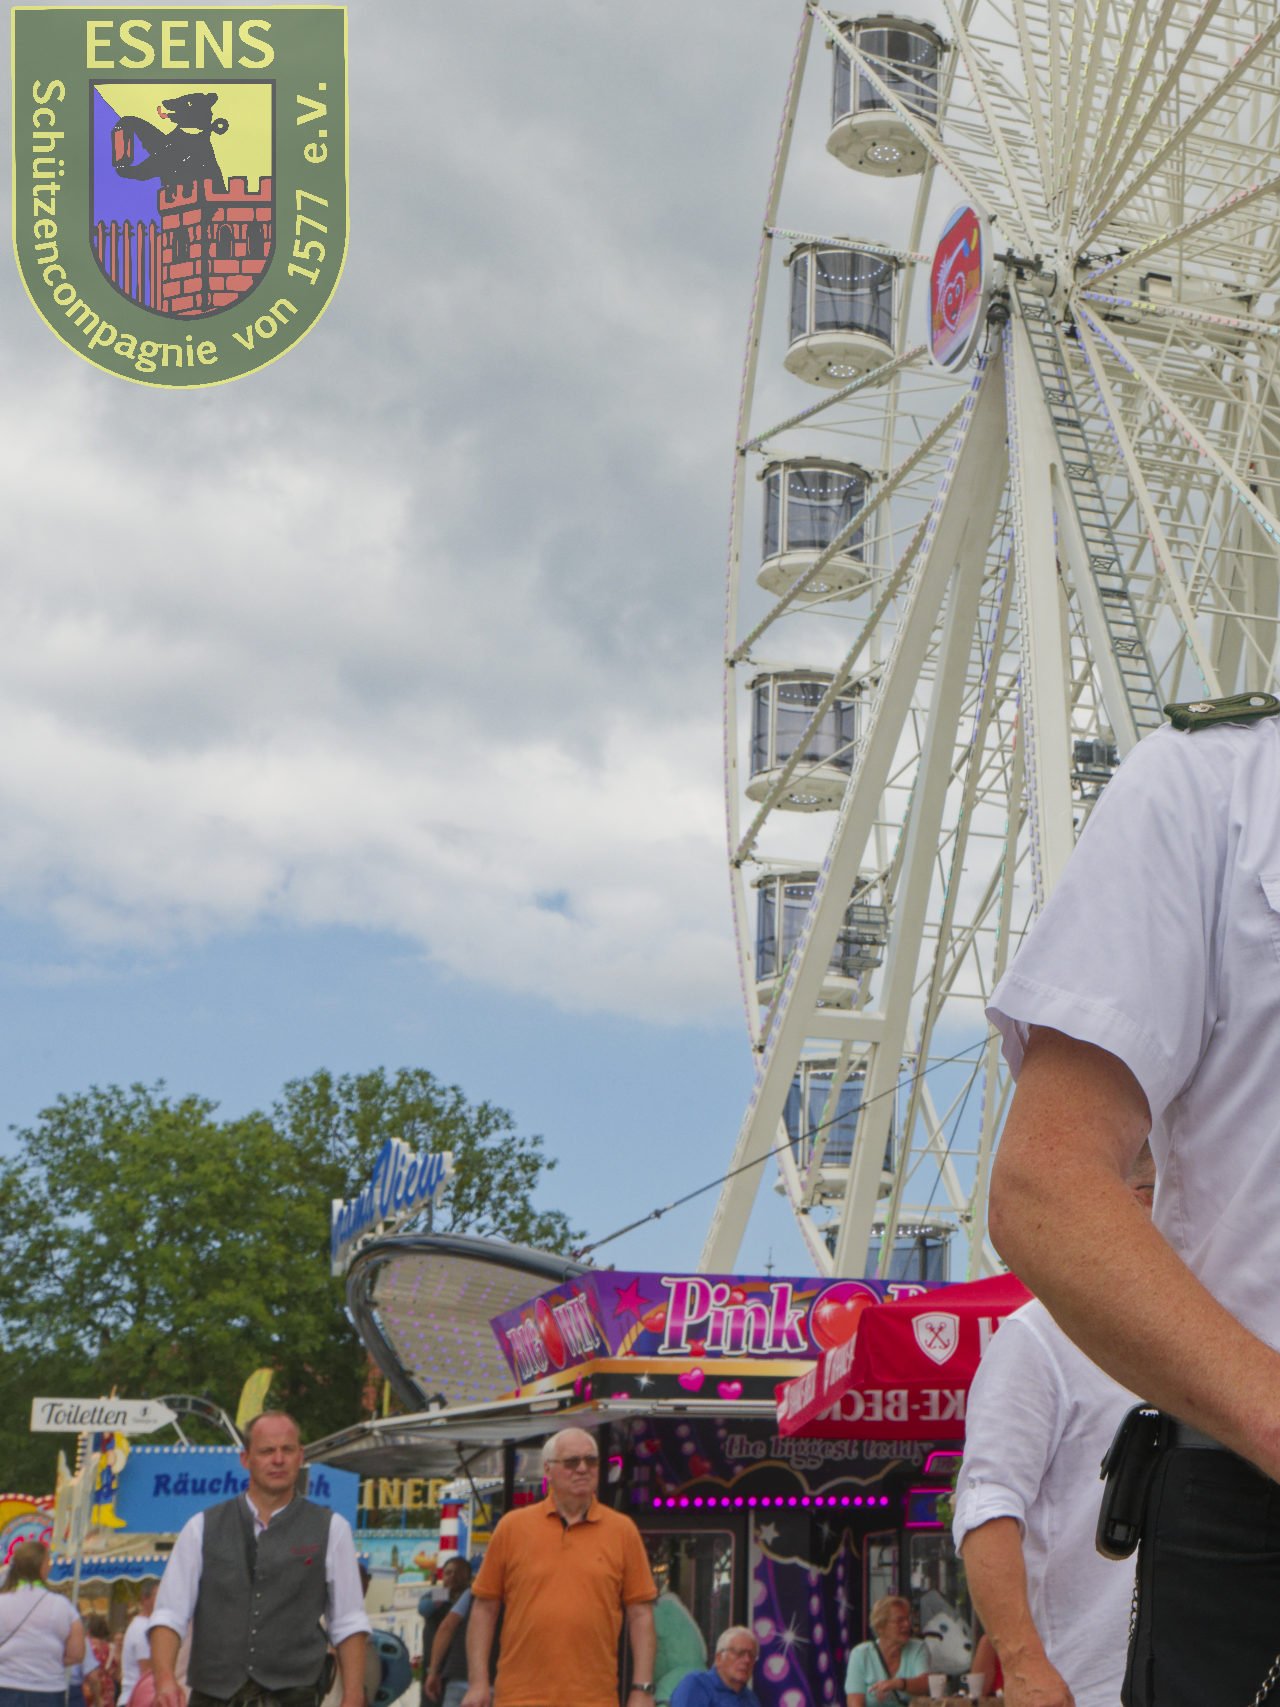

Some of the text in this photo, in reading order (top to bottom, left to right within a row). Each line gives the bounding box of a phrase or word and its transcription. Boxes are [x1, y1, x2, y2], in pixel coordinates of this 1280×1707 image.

[371, 1138, 446, 1219] View
[657, 1276, 808, 1355] Pink
[41, 1403, 128, 1426] Toiletten
